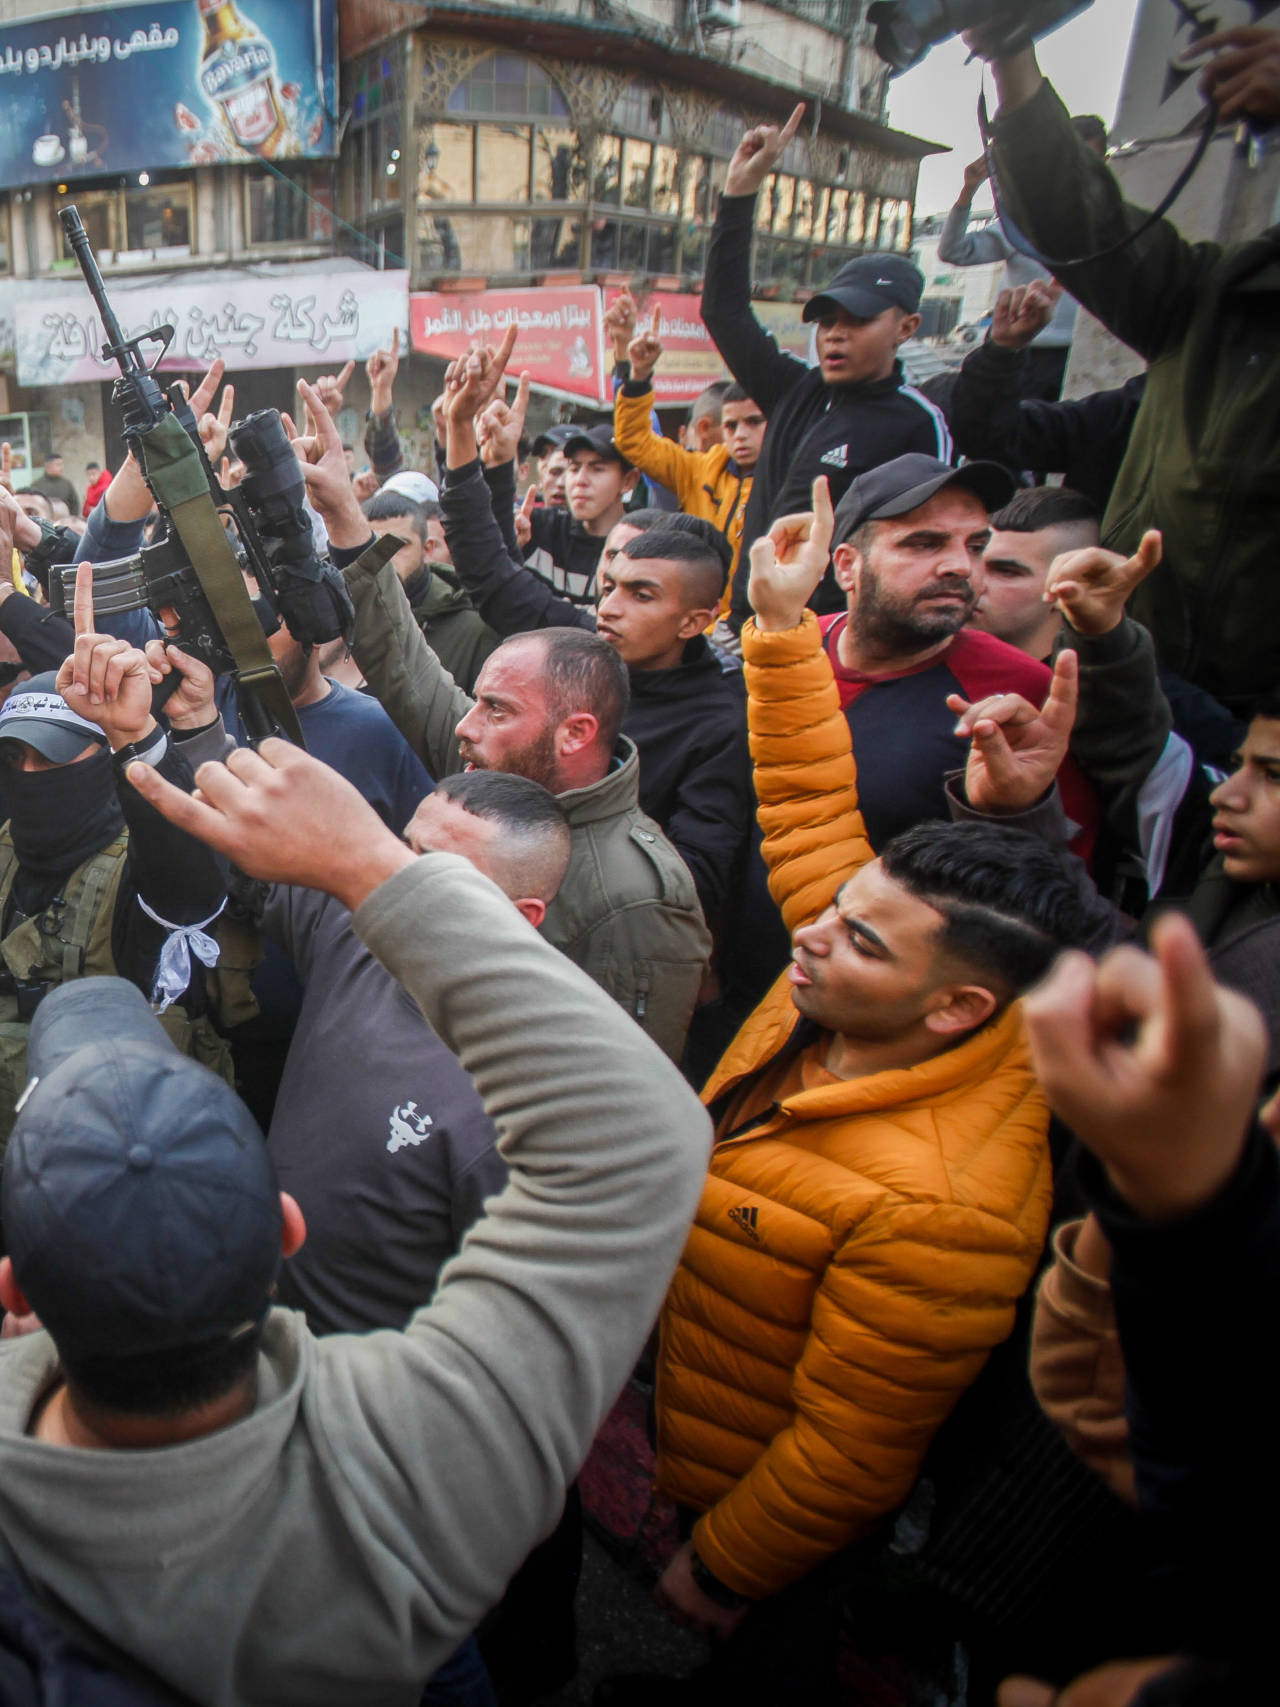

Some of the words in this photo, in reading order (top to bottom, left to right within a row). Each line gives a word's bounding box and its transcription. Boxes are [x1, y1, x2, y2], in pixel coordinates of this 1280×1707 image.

[23, 32, 112, 74] وبلياردو
[114, 22, 180, 60] مقهى
[203, 46, 270, 95] Bavaria
[42, 306, 179, 368] للصافة
[185, 301, 266, 360] جنين
[270, 288, 360, 352] شركة
